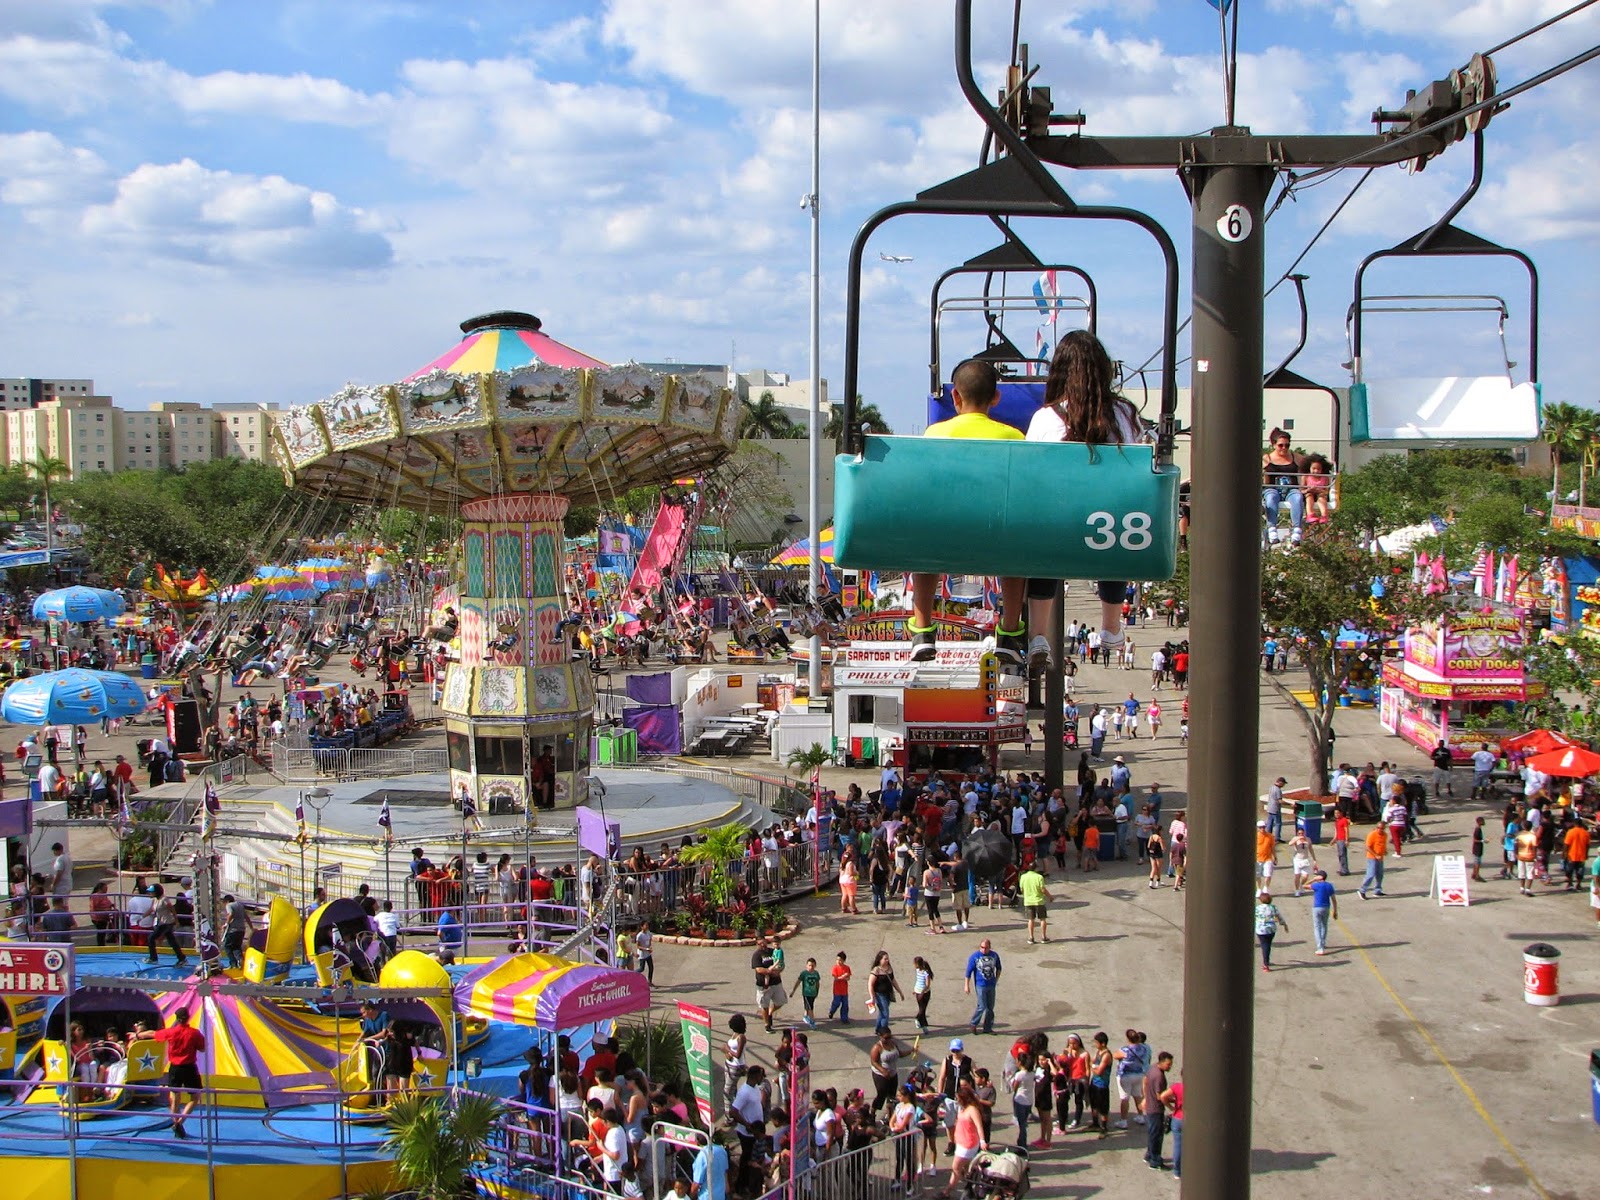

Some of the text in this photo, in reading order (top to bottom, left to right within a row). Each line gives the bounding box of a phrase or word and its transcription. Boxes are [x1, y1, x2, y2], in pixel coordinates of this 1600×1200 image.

[1228, 209, 1242, 239] 6
[1084, 511, 1153, 551] 38
[848, 651, 891, 661] SARATOGA
[1448, 660, 1520, 670] CORN DOGS
[997, 687, 1022, 698] FRIES
[578, 985, 631, 1009] TILT-A-WHIRL
